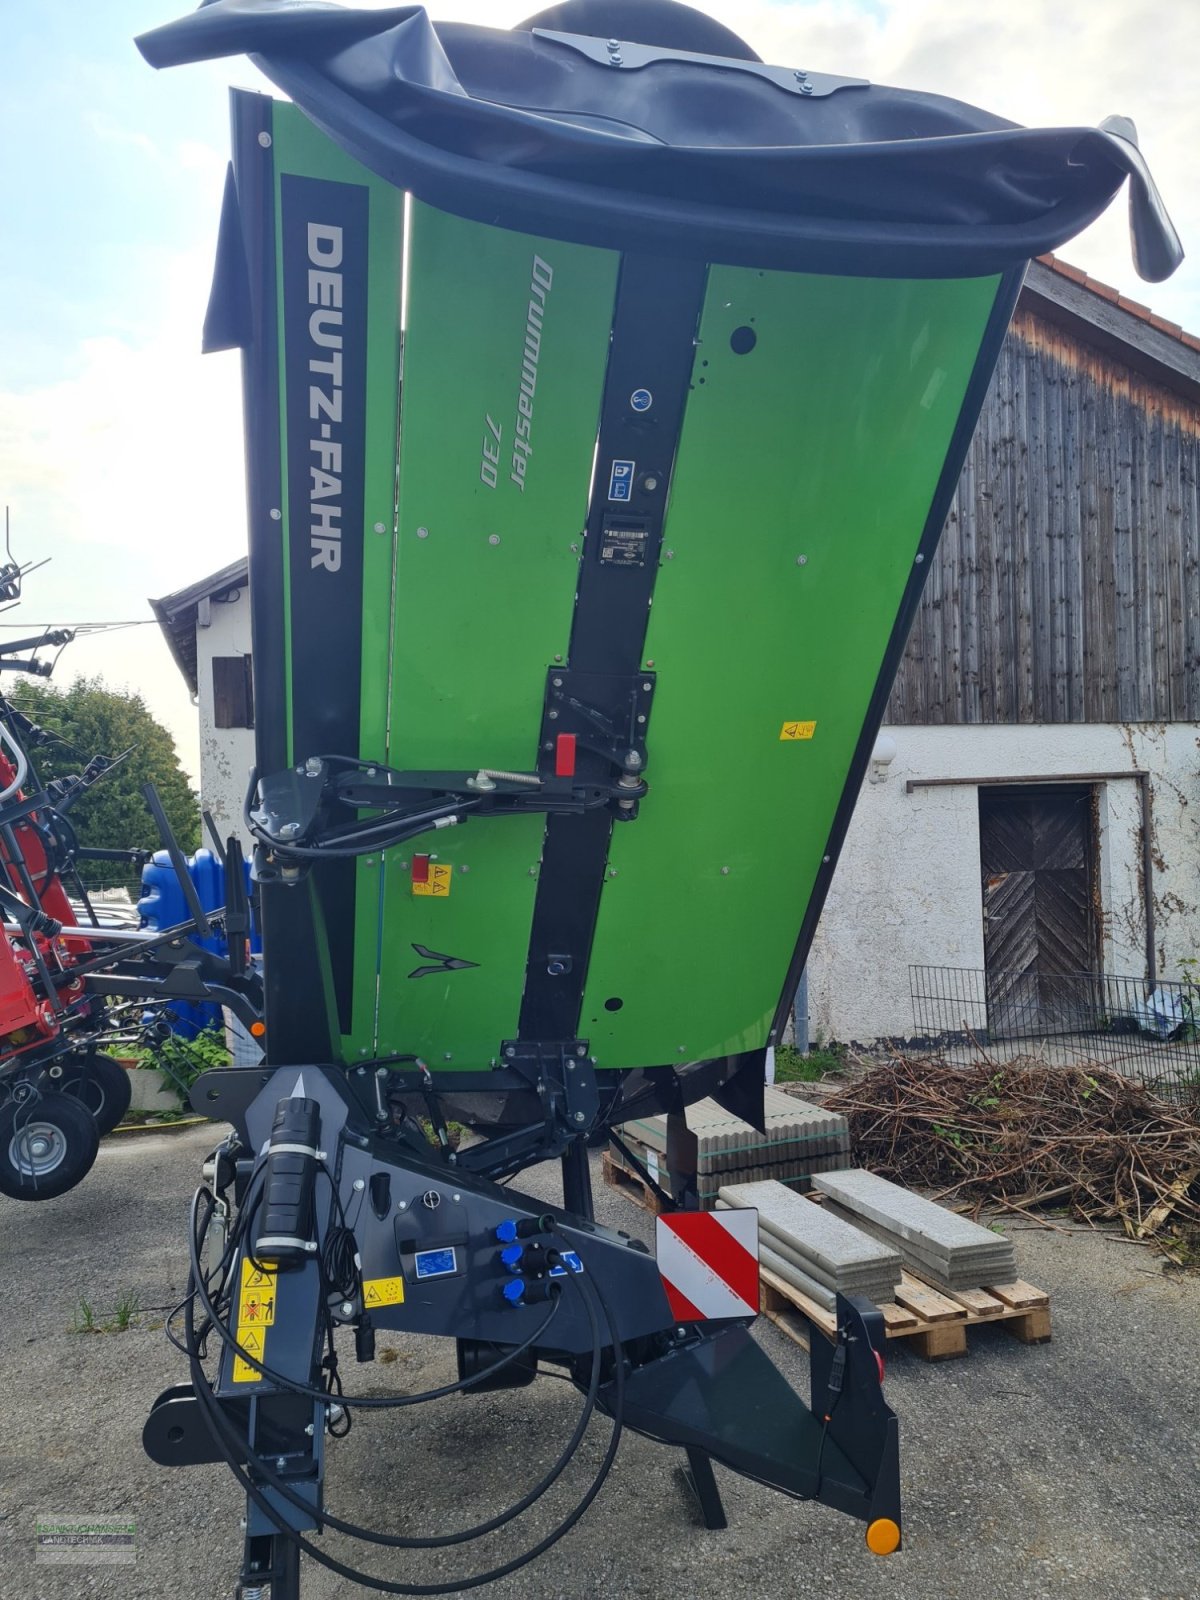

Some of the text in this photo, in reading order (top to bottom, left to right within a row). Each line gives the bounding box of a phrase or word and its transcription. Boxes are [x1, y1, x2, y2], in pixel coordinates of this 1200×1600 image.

[307, 222, 343, 573] DEUTZ-FAHR
[479, 413, 502, 490] 730
[510, 254, 554, 492] Drummaster
